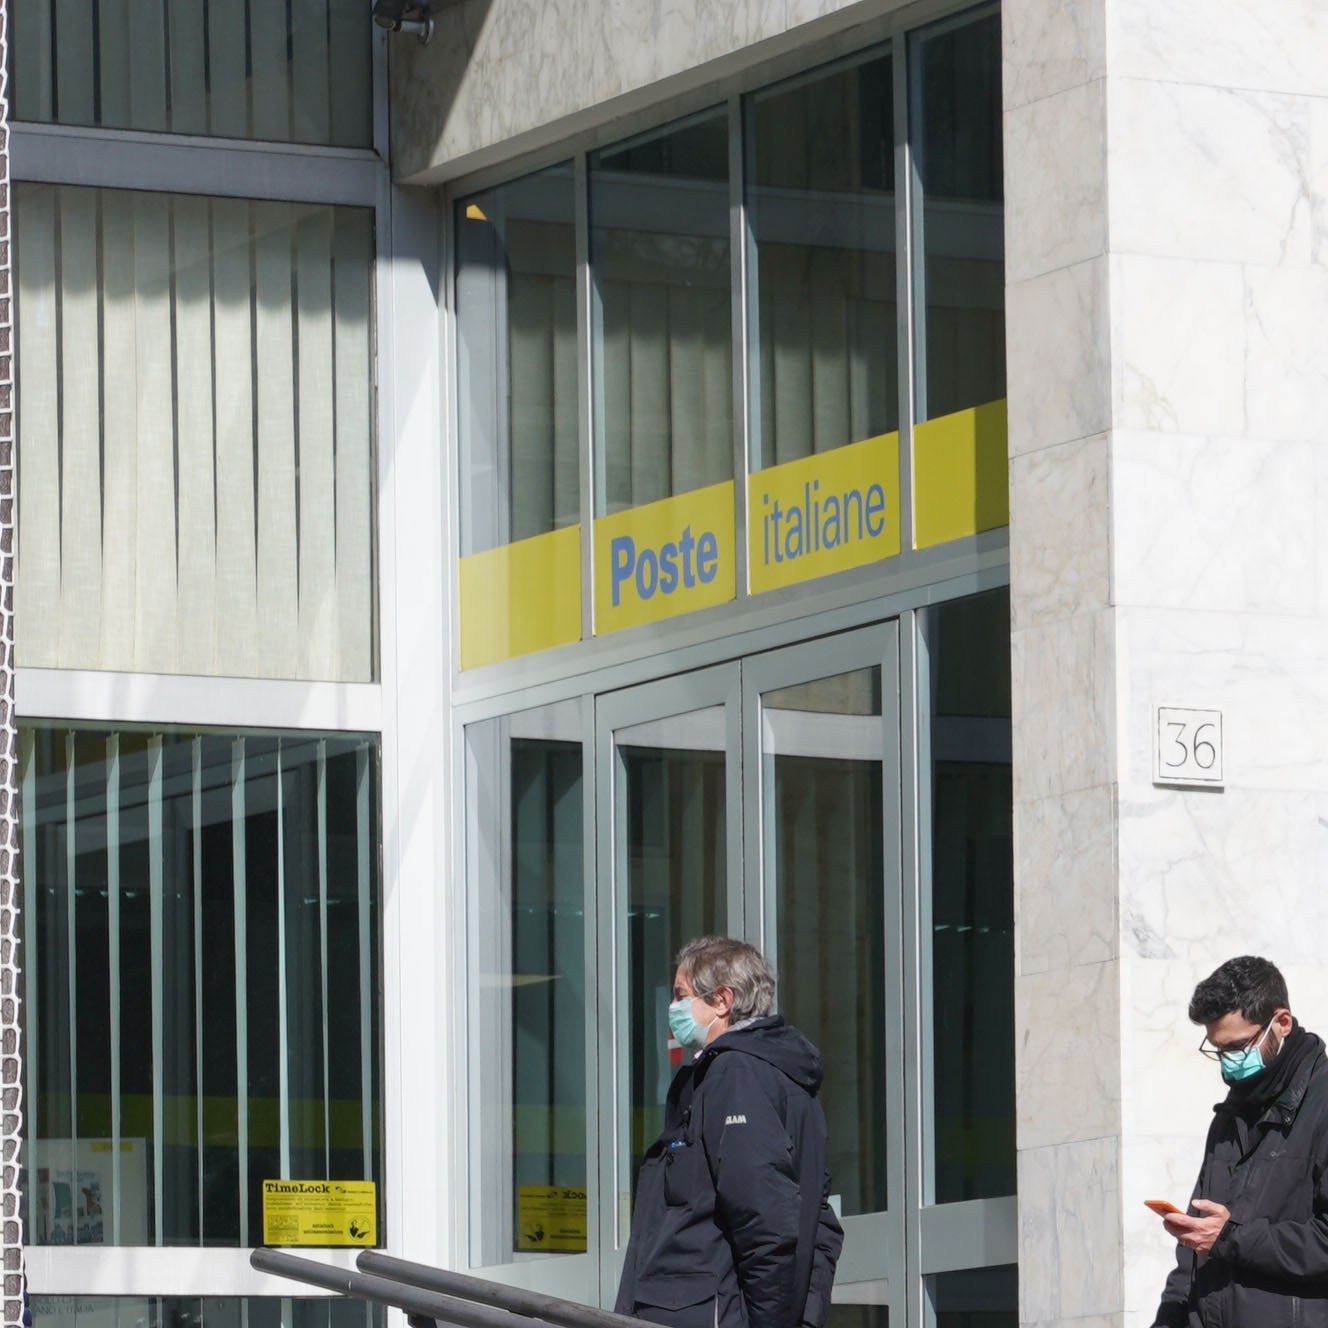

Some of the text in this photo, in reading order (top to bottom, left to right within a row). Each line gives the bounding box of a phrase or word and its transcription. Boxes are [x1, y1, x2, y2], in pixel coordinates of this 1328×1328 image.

[611, 479, 885, 608] Poste italiane
[1165, 722, 1216, 769] 36
[265, 1183, 331, 1194] TimeLock
